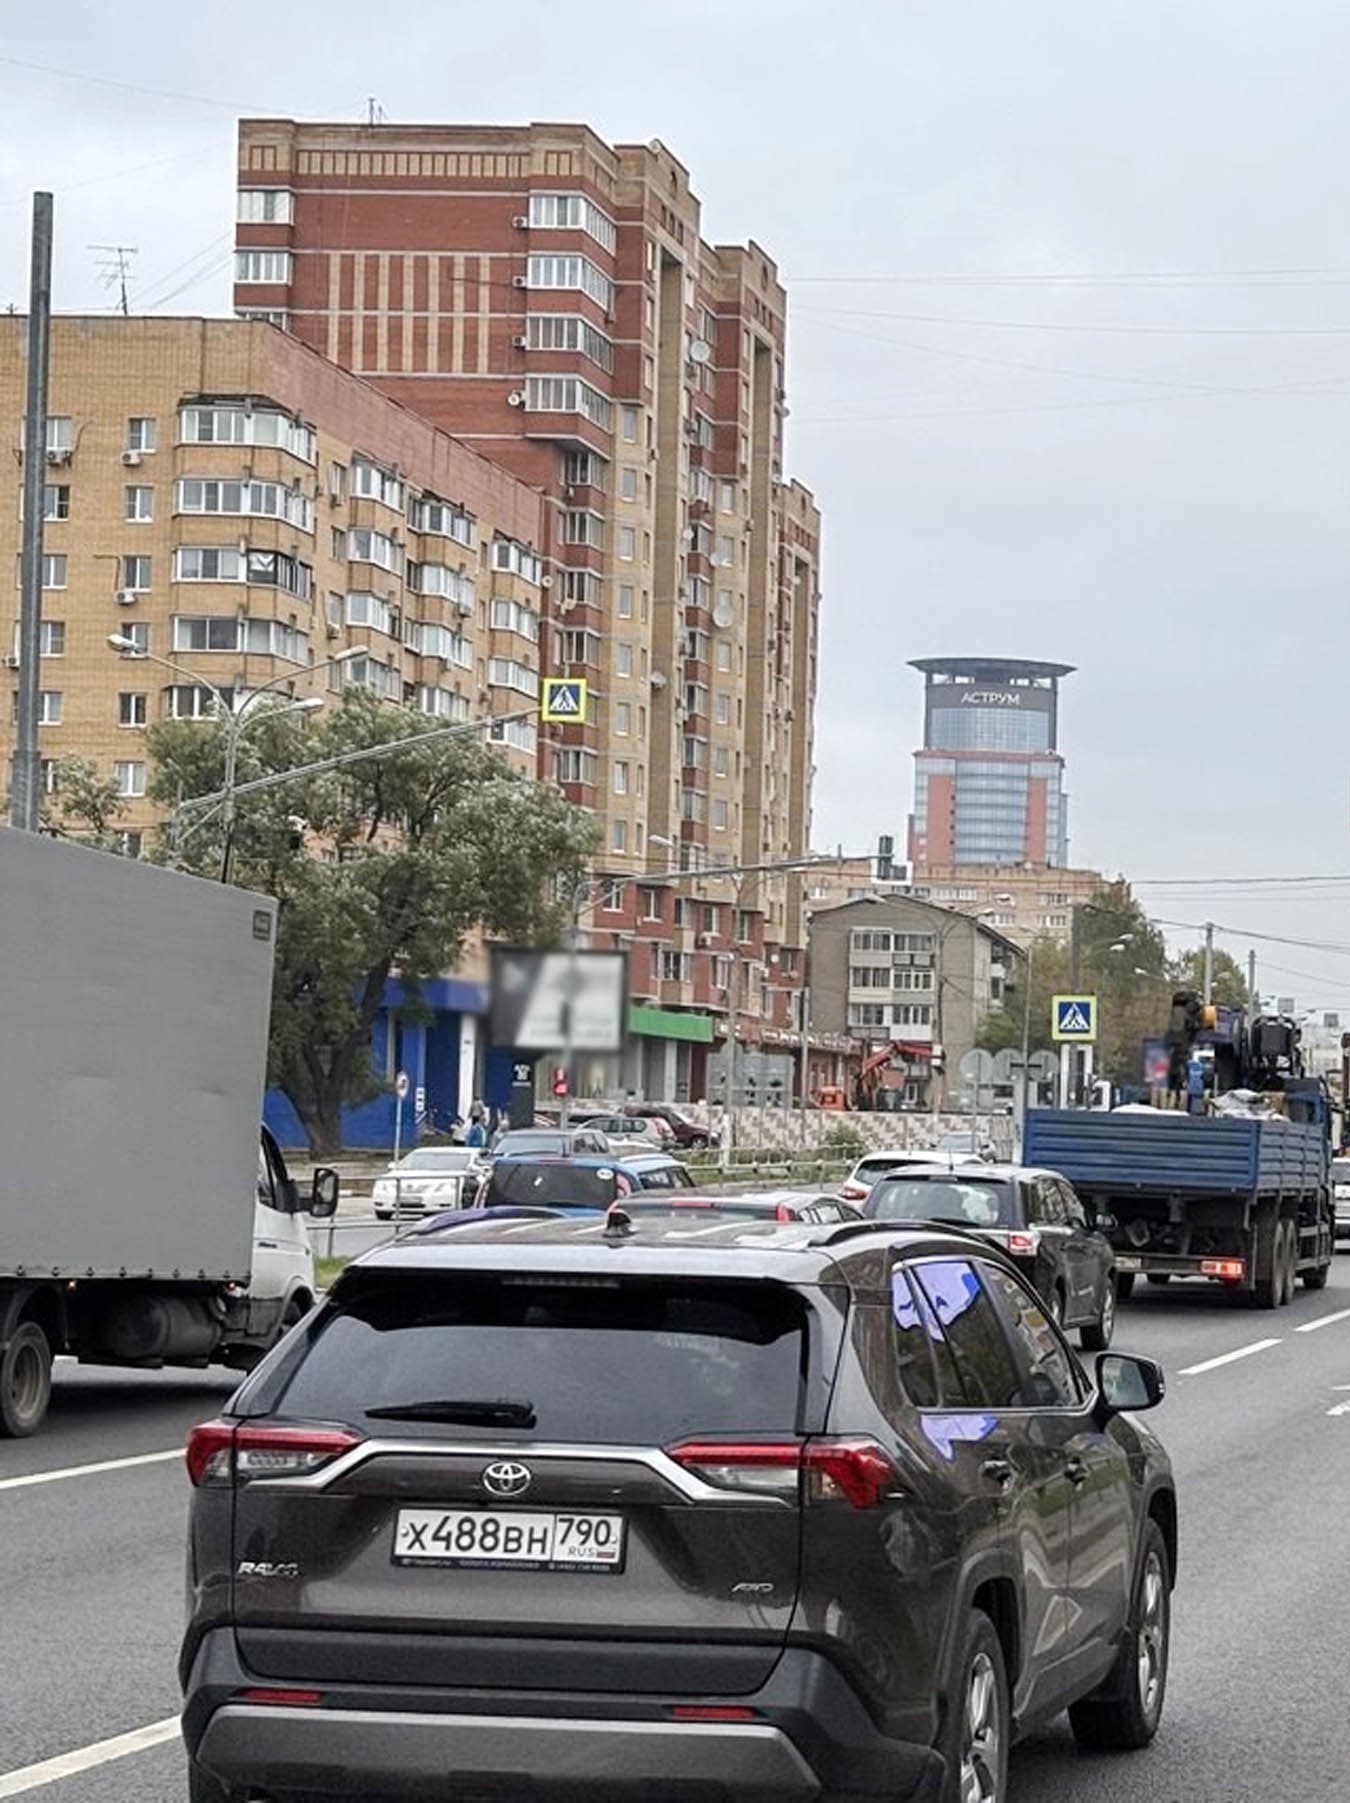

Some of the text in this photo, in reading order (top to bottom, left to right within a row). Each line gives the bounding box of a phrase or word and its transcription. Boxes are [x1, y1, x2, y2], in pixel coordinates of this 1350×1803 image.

[961, 691, 1021, 706] АСТРУМ
[557, 1517, 612, 1546] 790
[568, 1545, 596, 1557] RUS
